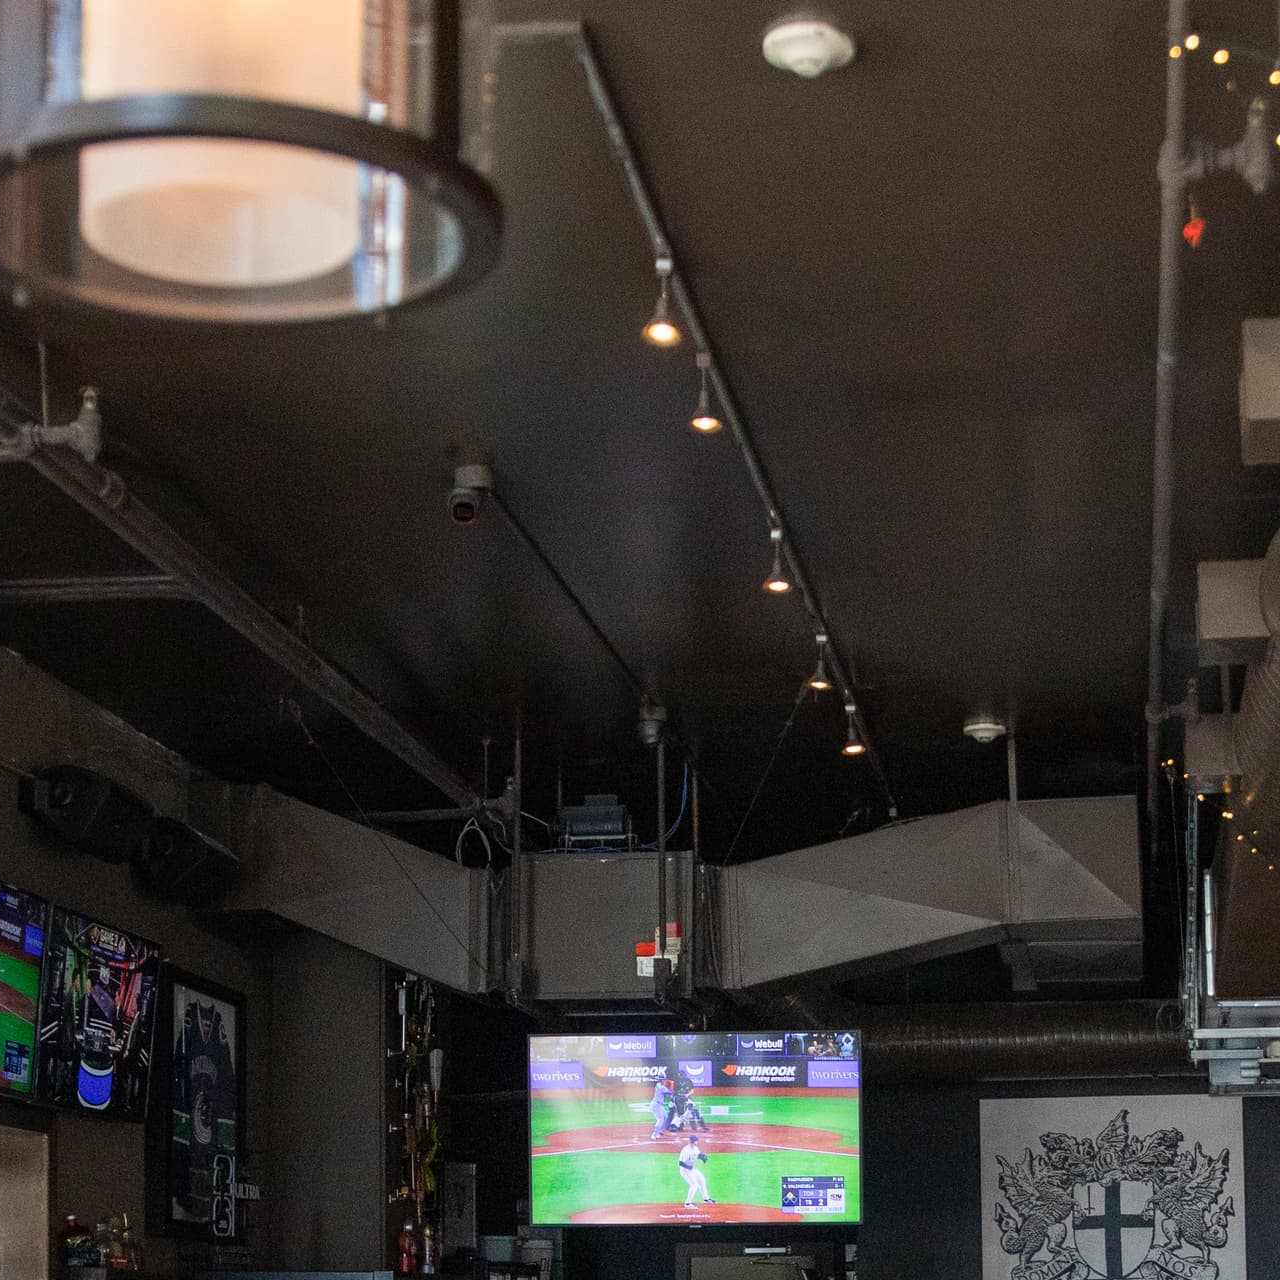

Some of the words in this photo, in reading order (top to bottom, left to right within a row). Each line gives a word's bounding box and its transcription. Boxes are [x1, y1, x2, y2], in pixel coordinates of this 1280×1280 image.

[623, 1041, 652, 1050] Webull
[754, 1039, 783, 1049] Webull
[1157, 1252, 1198, 1277] NOS
